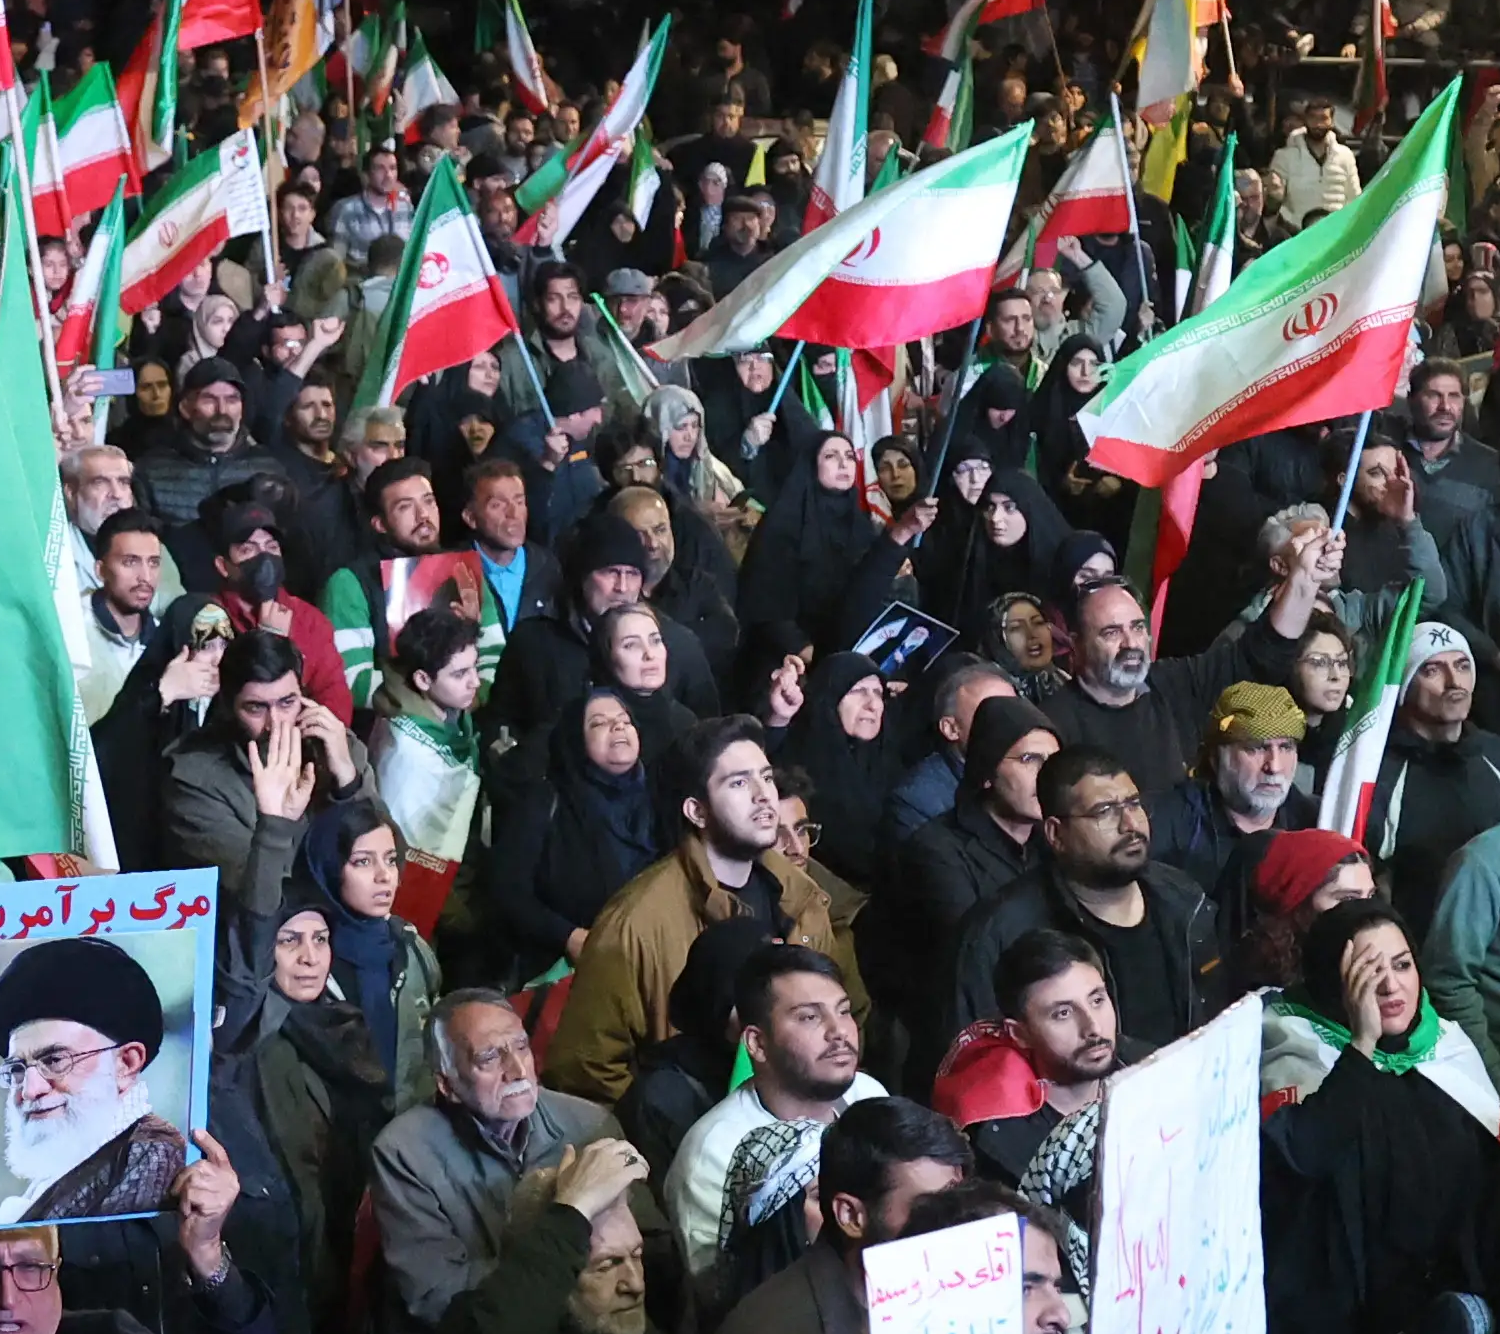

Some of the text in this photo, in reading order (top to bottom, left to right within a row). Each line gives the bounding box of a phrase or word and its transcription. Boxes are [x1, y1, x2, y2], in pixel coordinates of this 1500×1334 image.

[1429, 627, 1453, 647] NY
[79, 899, 116, 936] بر
[130, 882, 212, 930] مرگ
[968, 1231, 1014, 1289] آقای
